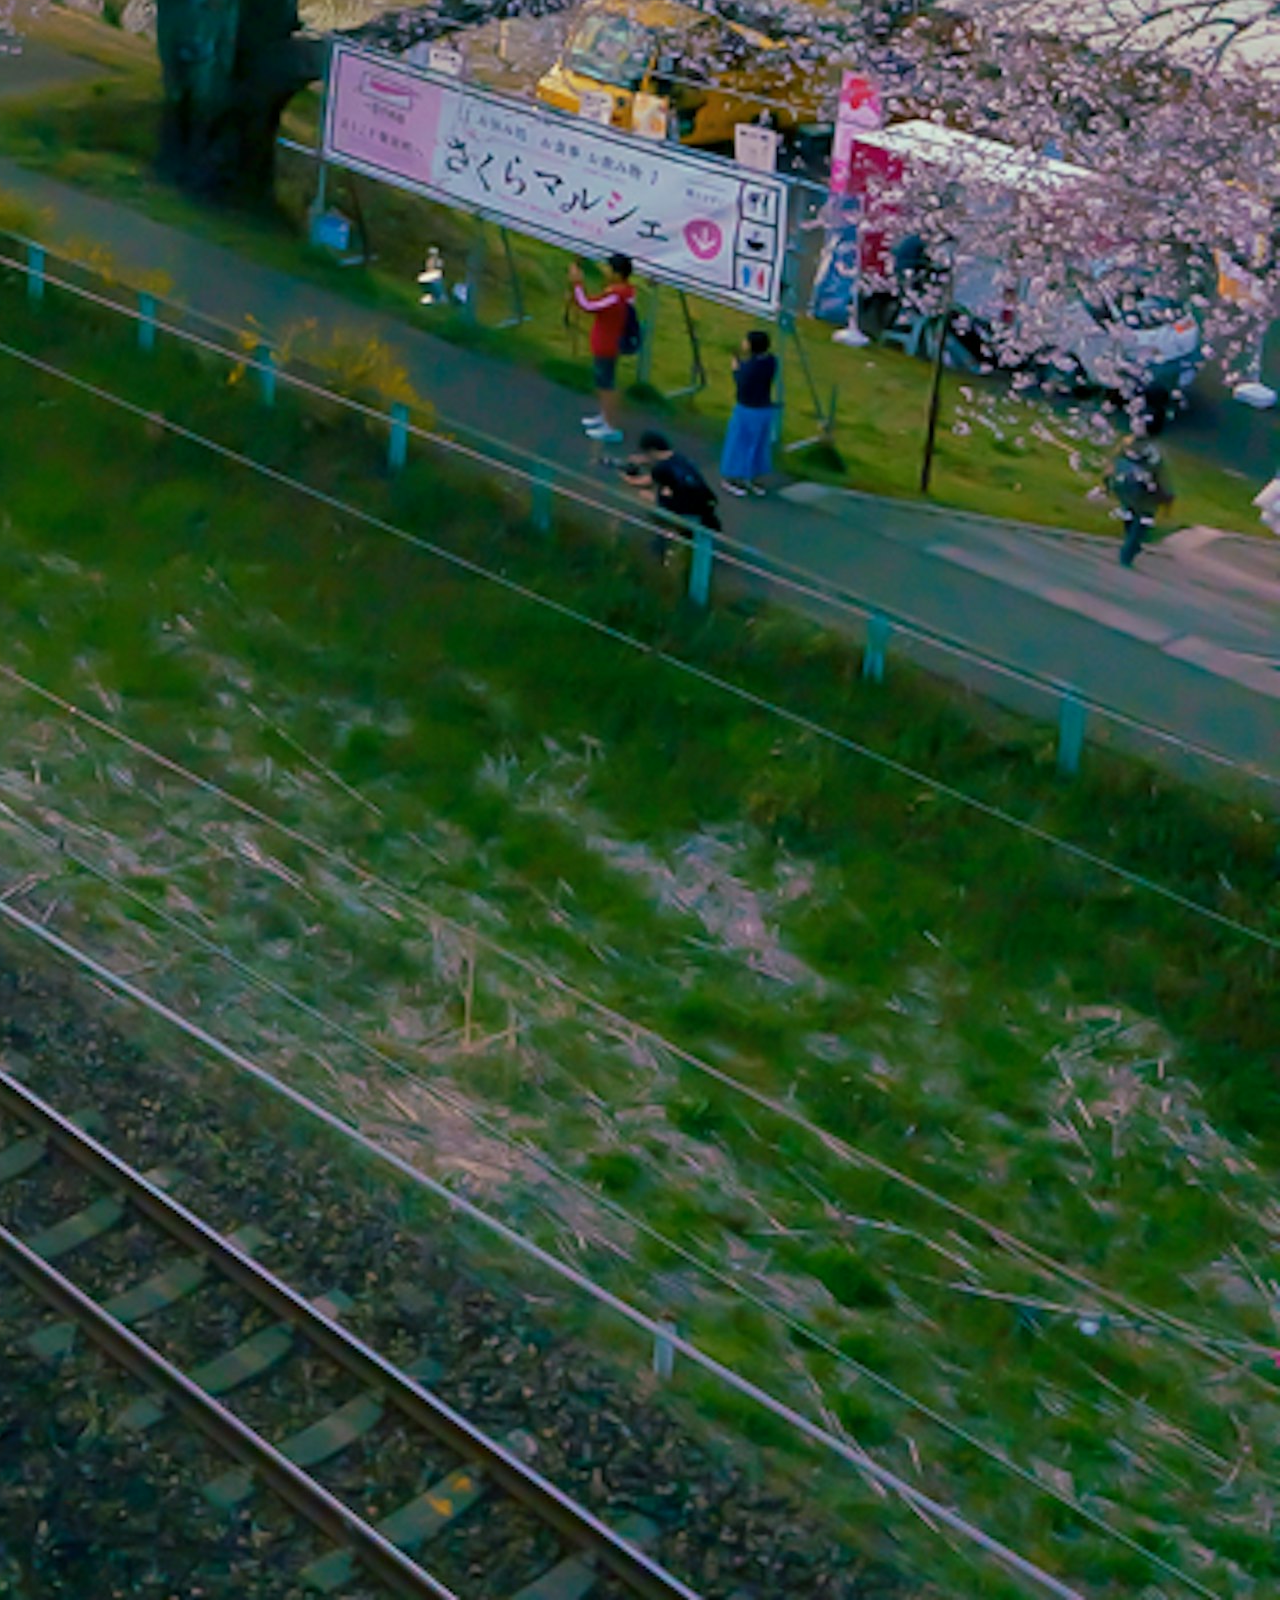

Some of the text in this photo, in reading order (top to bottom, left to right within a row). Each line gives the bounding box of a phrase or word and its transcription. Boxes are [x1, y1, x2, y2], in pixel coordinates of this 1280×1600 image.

[446, 136, 669, 241] さくらマルシェ
